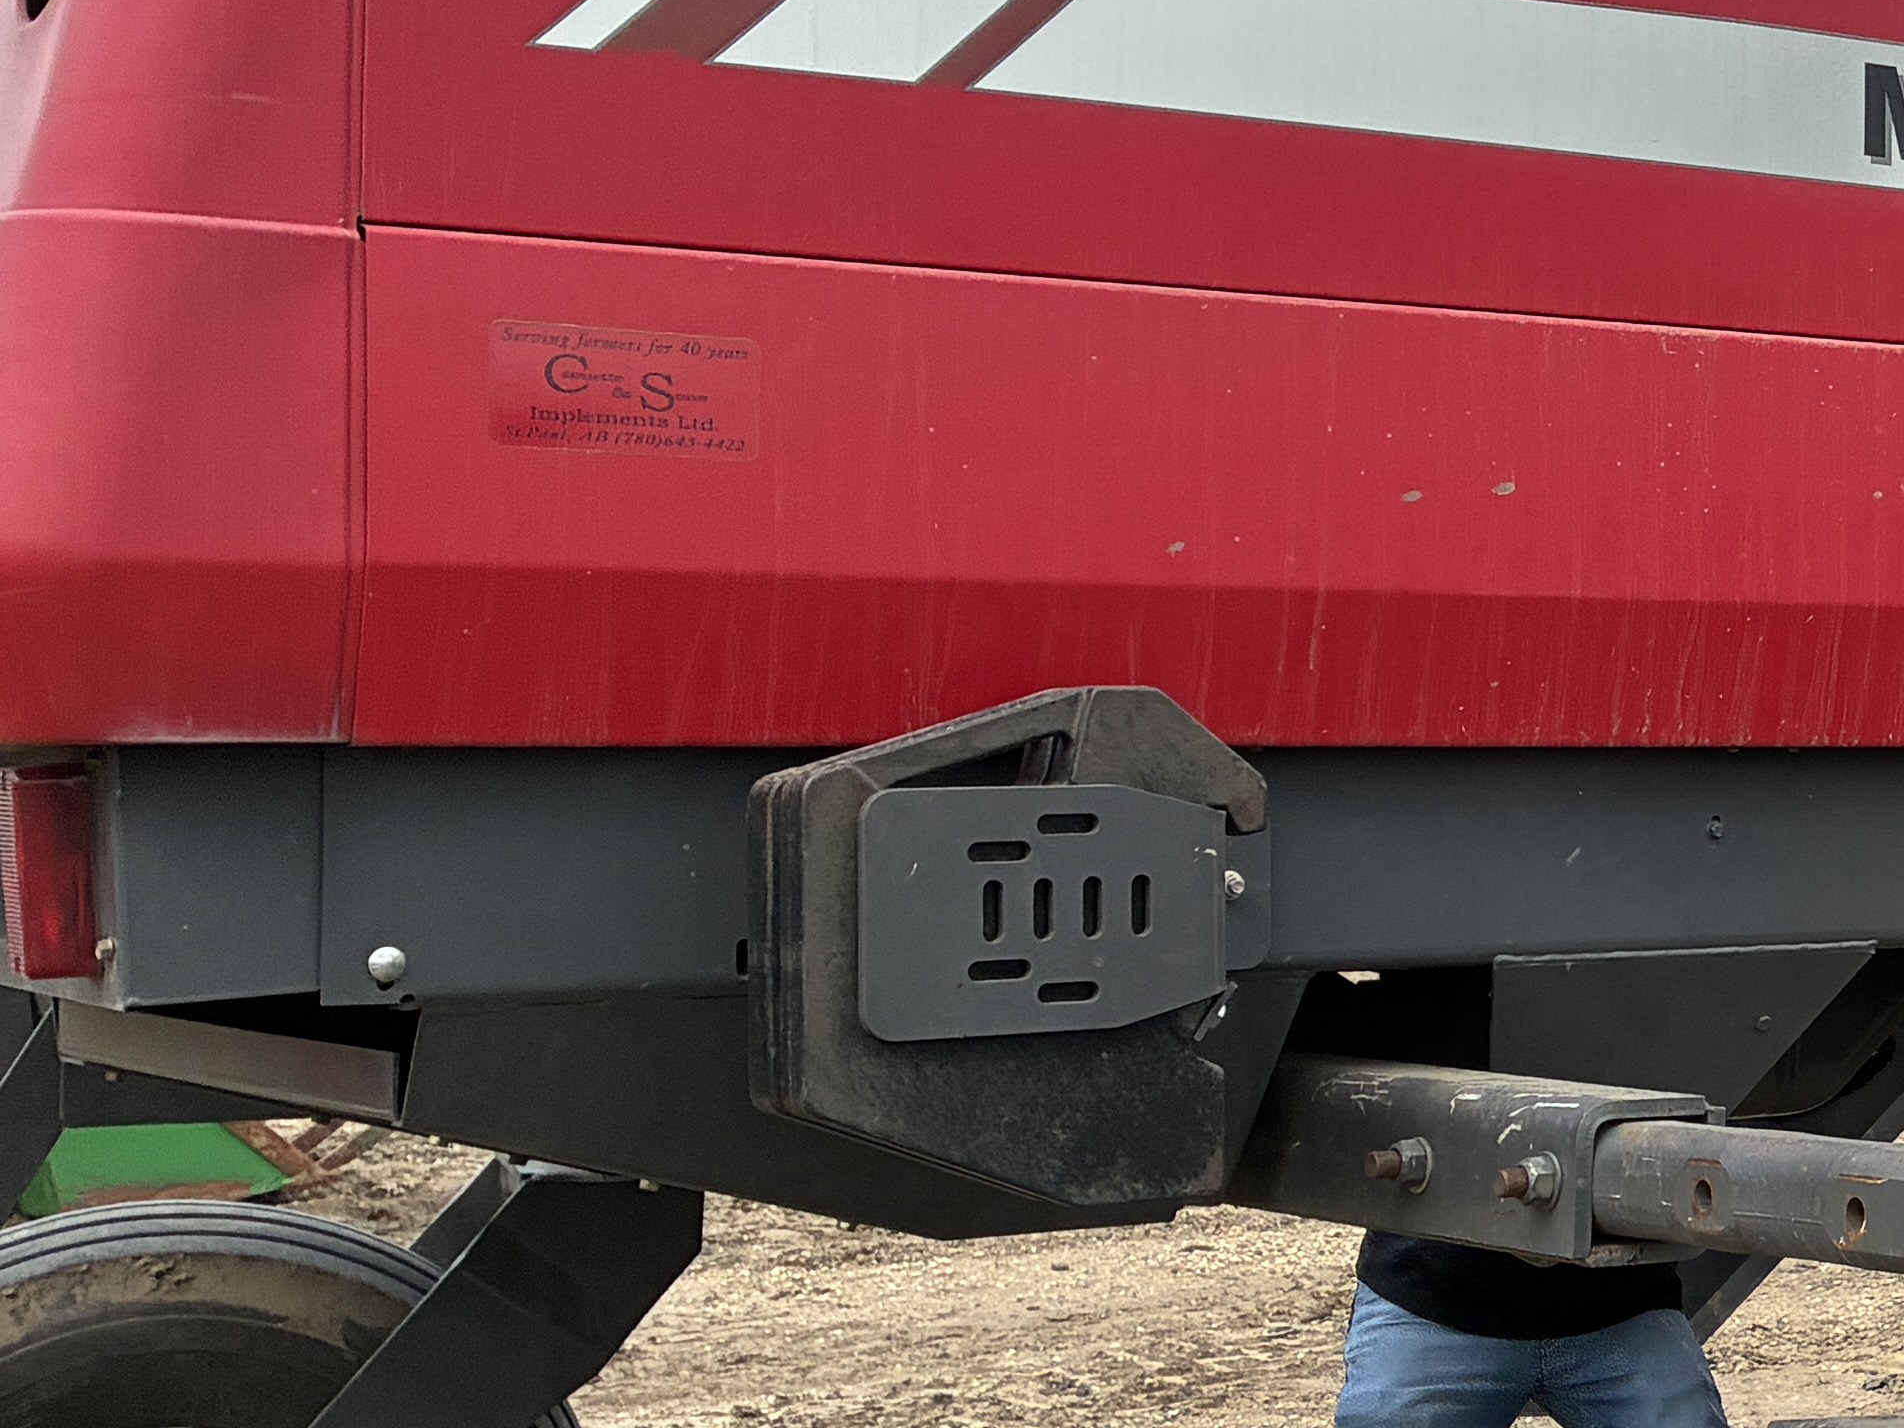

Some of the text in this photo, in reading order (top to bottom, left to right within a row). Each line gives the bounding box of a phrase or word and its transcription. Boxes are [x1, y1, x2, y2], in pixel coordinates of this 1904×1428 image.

[681, 341, 701, 356] 40
[530, 406, 718, 432] Implements Ltd.
